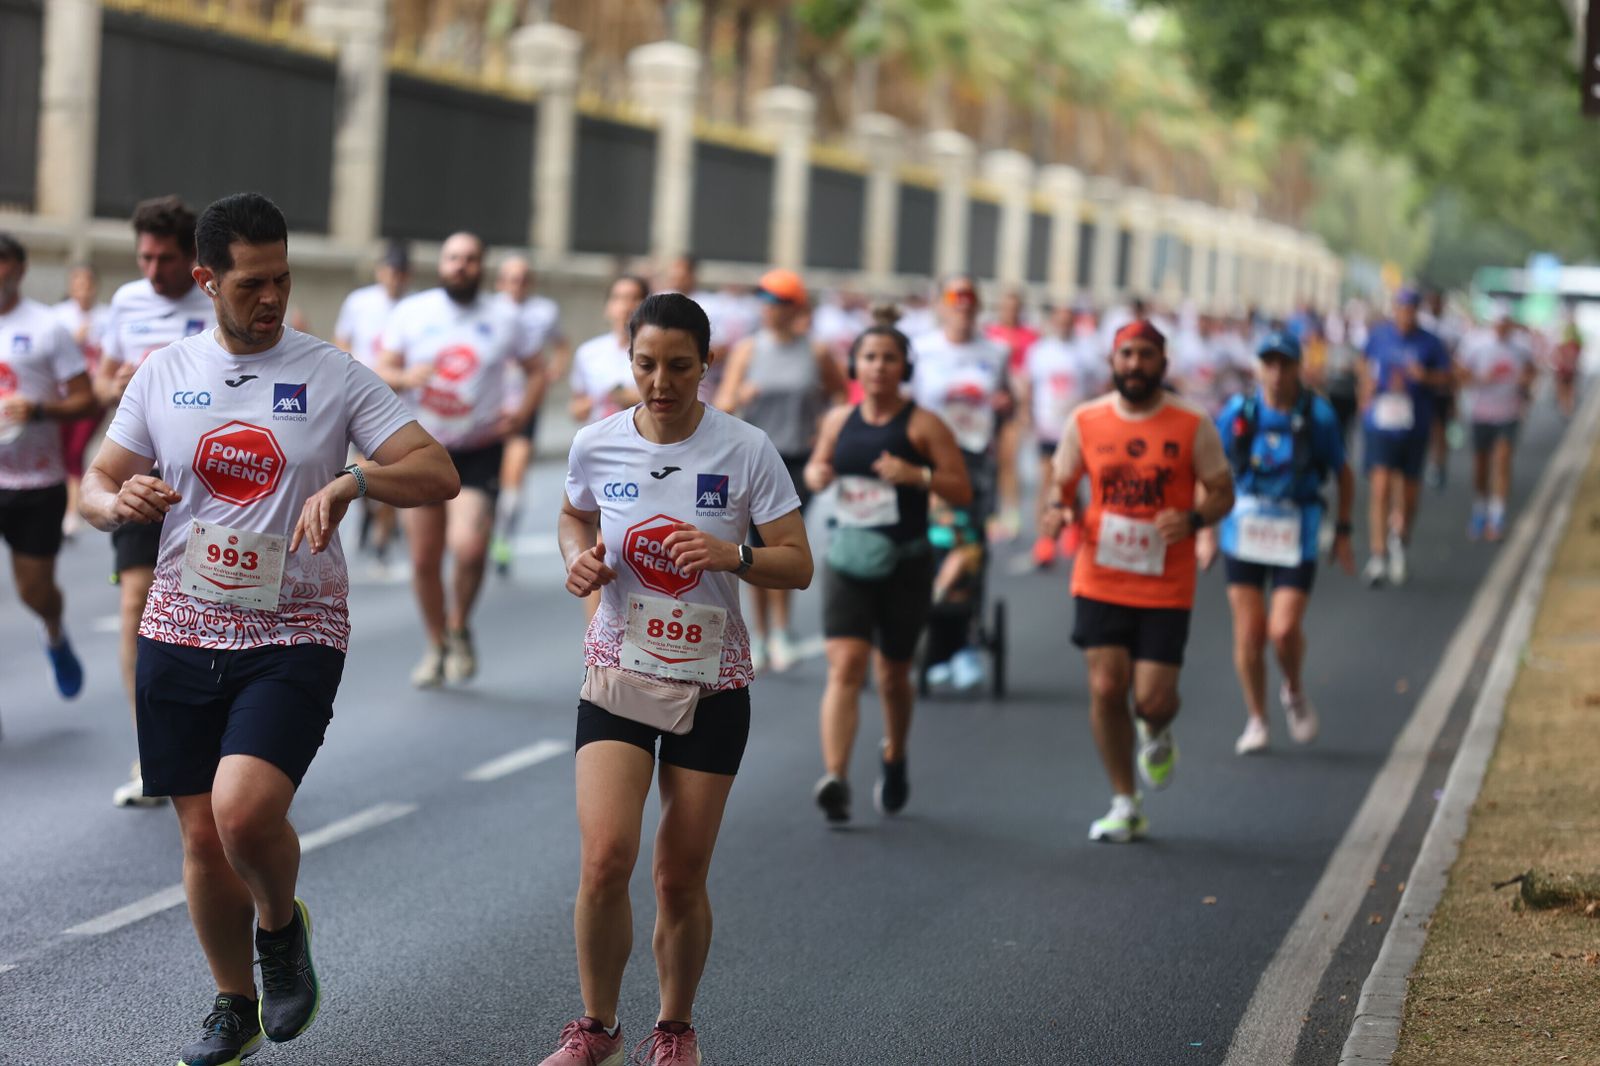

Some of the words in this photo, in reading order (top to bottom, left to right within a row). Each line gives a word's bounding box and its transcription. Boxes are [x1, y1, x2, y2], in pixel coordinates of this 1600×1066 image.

[272, 413, 308, 422] fundación
[273, 398, 301, 411] AXA
[209, 441, 274, 471] PONLE
[205, 458, 269, 486] FRENO
[696, 491, 722, 506] AXA
[206, 543, 259, 571] 993
[646, 618, 702, 644] 898
